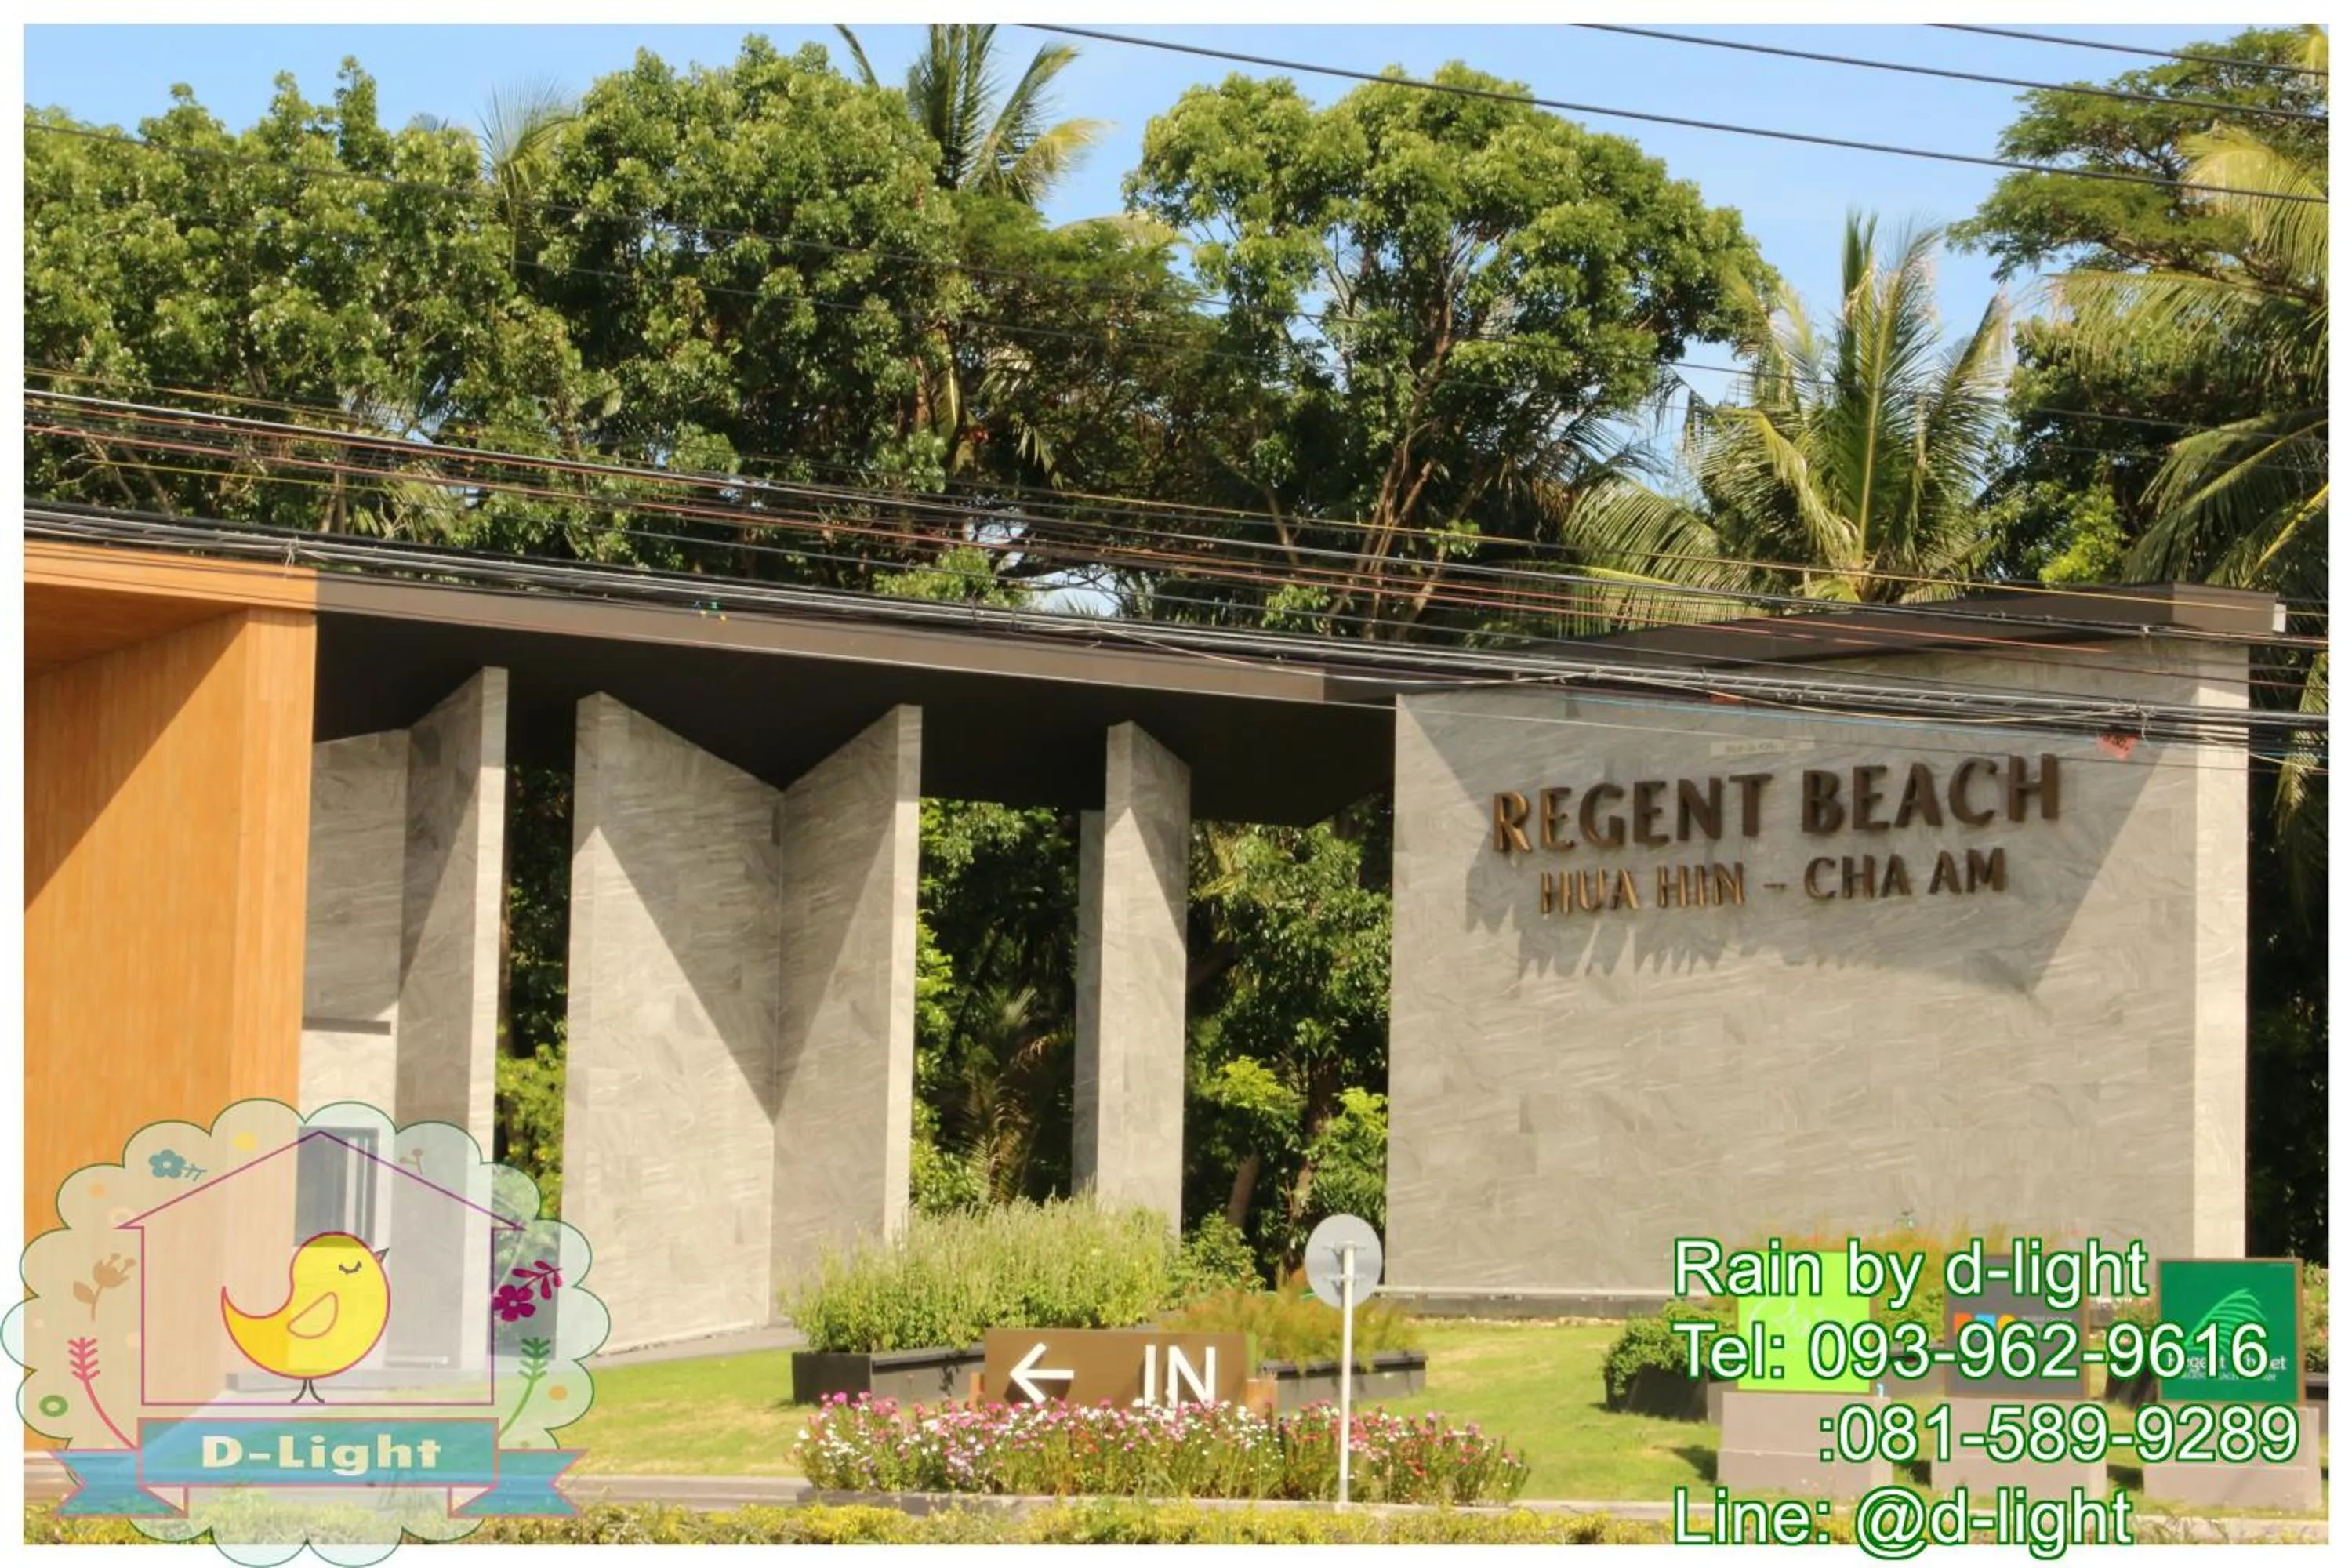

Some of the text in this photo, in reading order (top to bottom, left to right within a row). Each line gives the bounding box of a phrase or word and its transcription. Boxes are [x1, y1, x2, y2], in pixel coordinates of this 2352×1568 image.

[1493, 753, 2059, 852] REGENT BEACH
[1540, 868, 1639, 914] HUA
[1657, 862, 1744, 908] HIN
[1805, 853, 1912, 900] CHA
[1928, 848, 2008, 895] AM
[1144, 1345, 1216, 1410] IN
